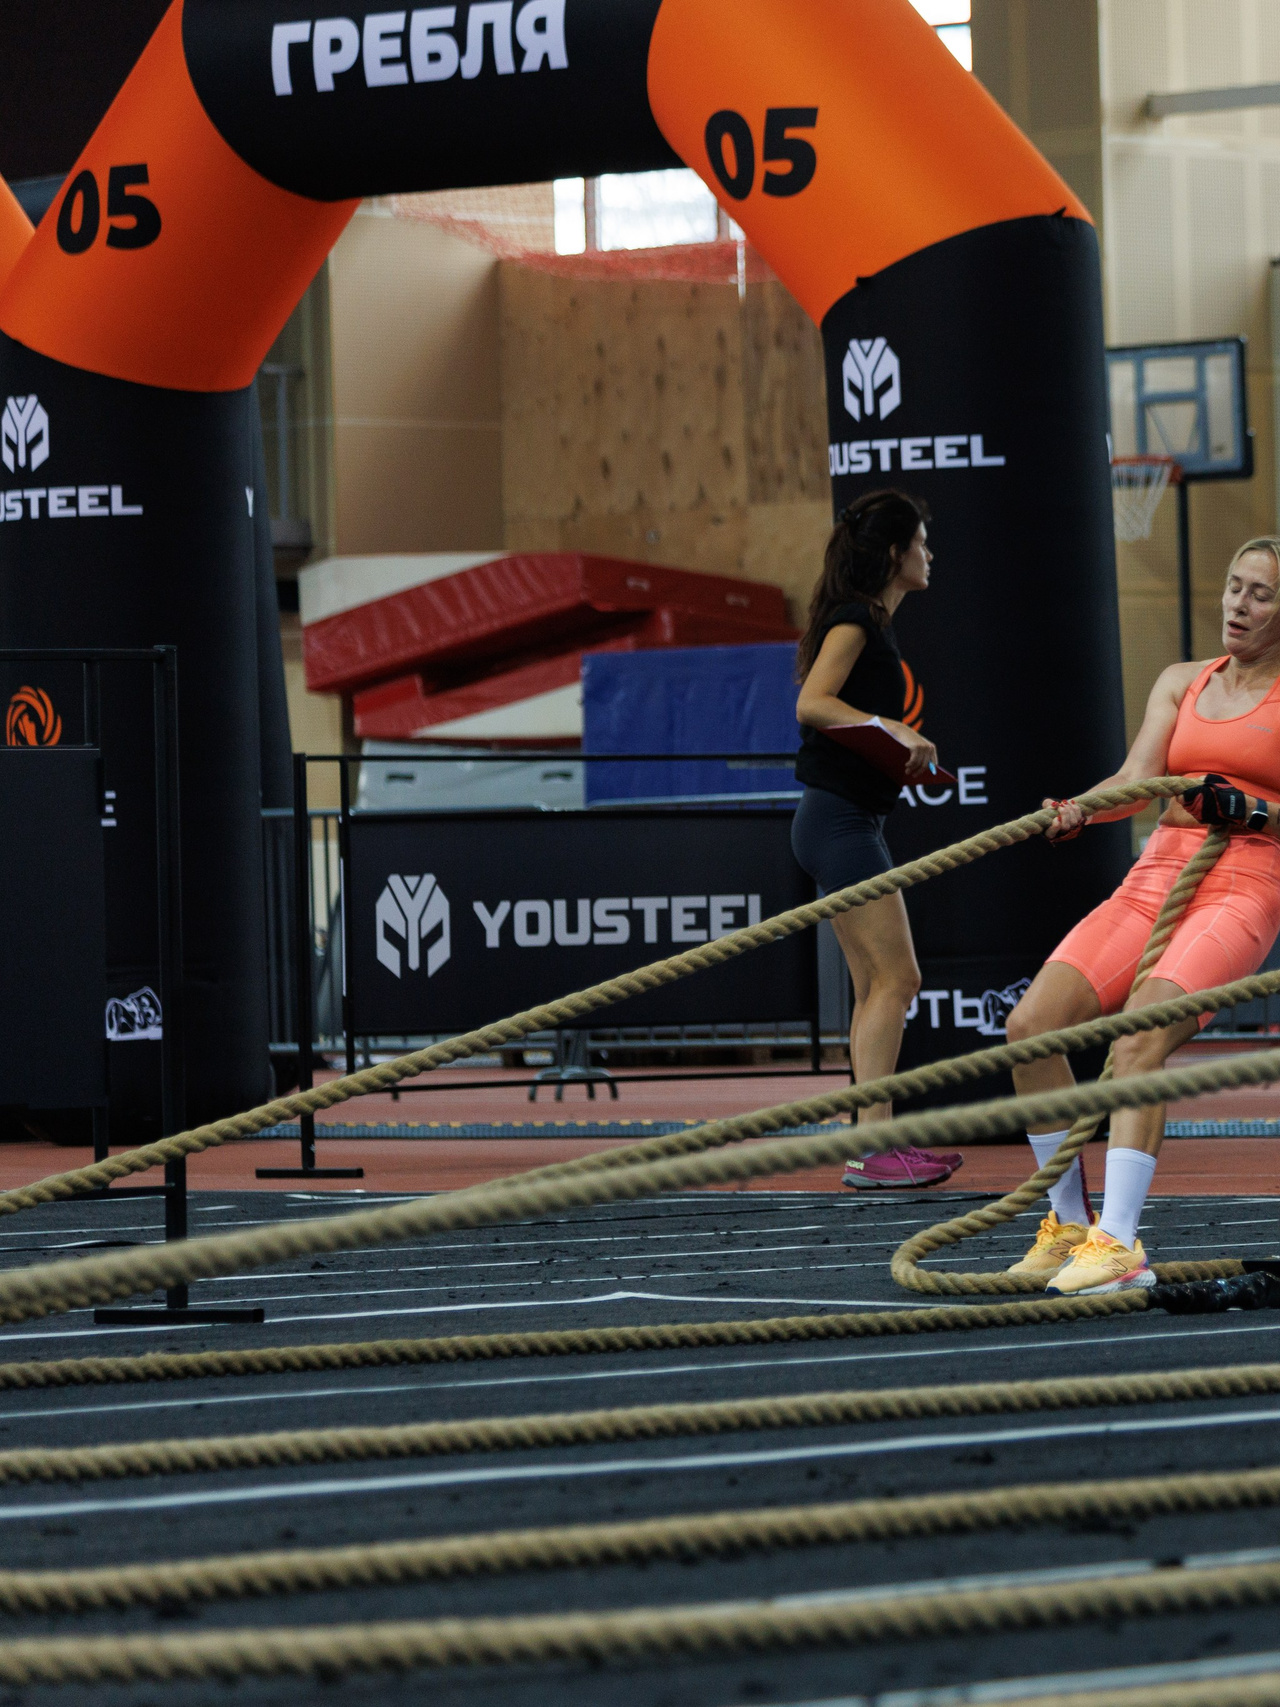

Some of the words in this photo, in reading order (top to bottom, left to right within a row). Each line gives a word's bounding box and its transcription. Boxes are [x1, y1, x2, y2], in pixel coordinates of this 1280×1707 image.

[271, 0, 568, 96] ГРЕБЛЯ
[704, 106, 818, 202] 05
[56, 163, 162, 255] 05
